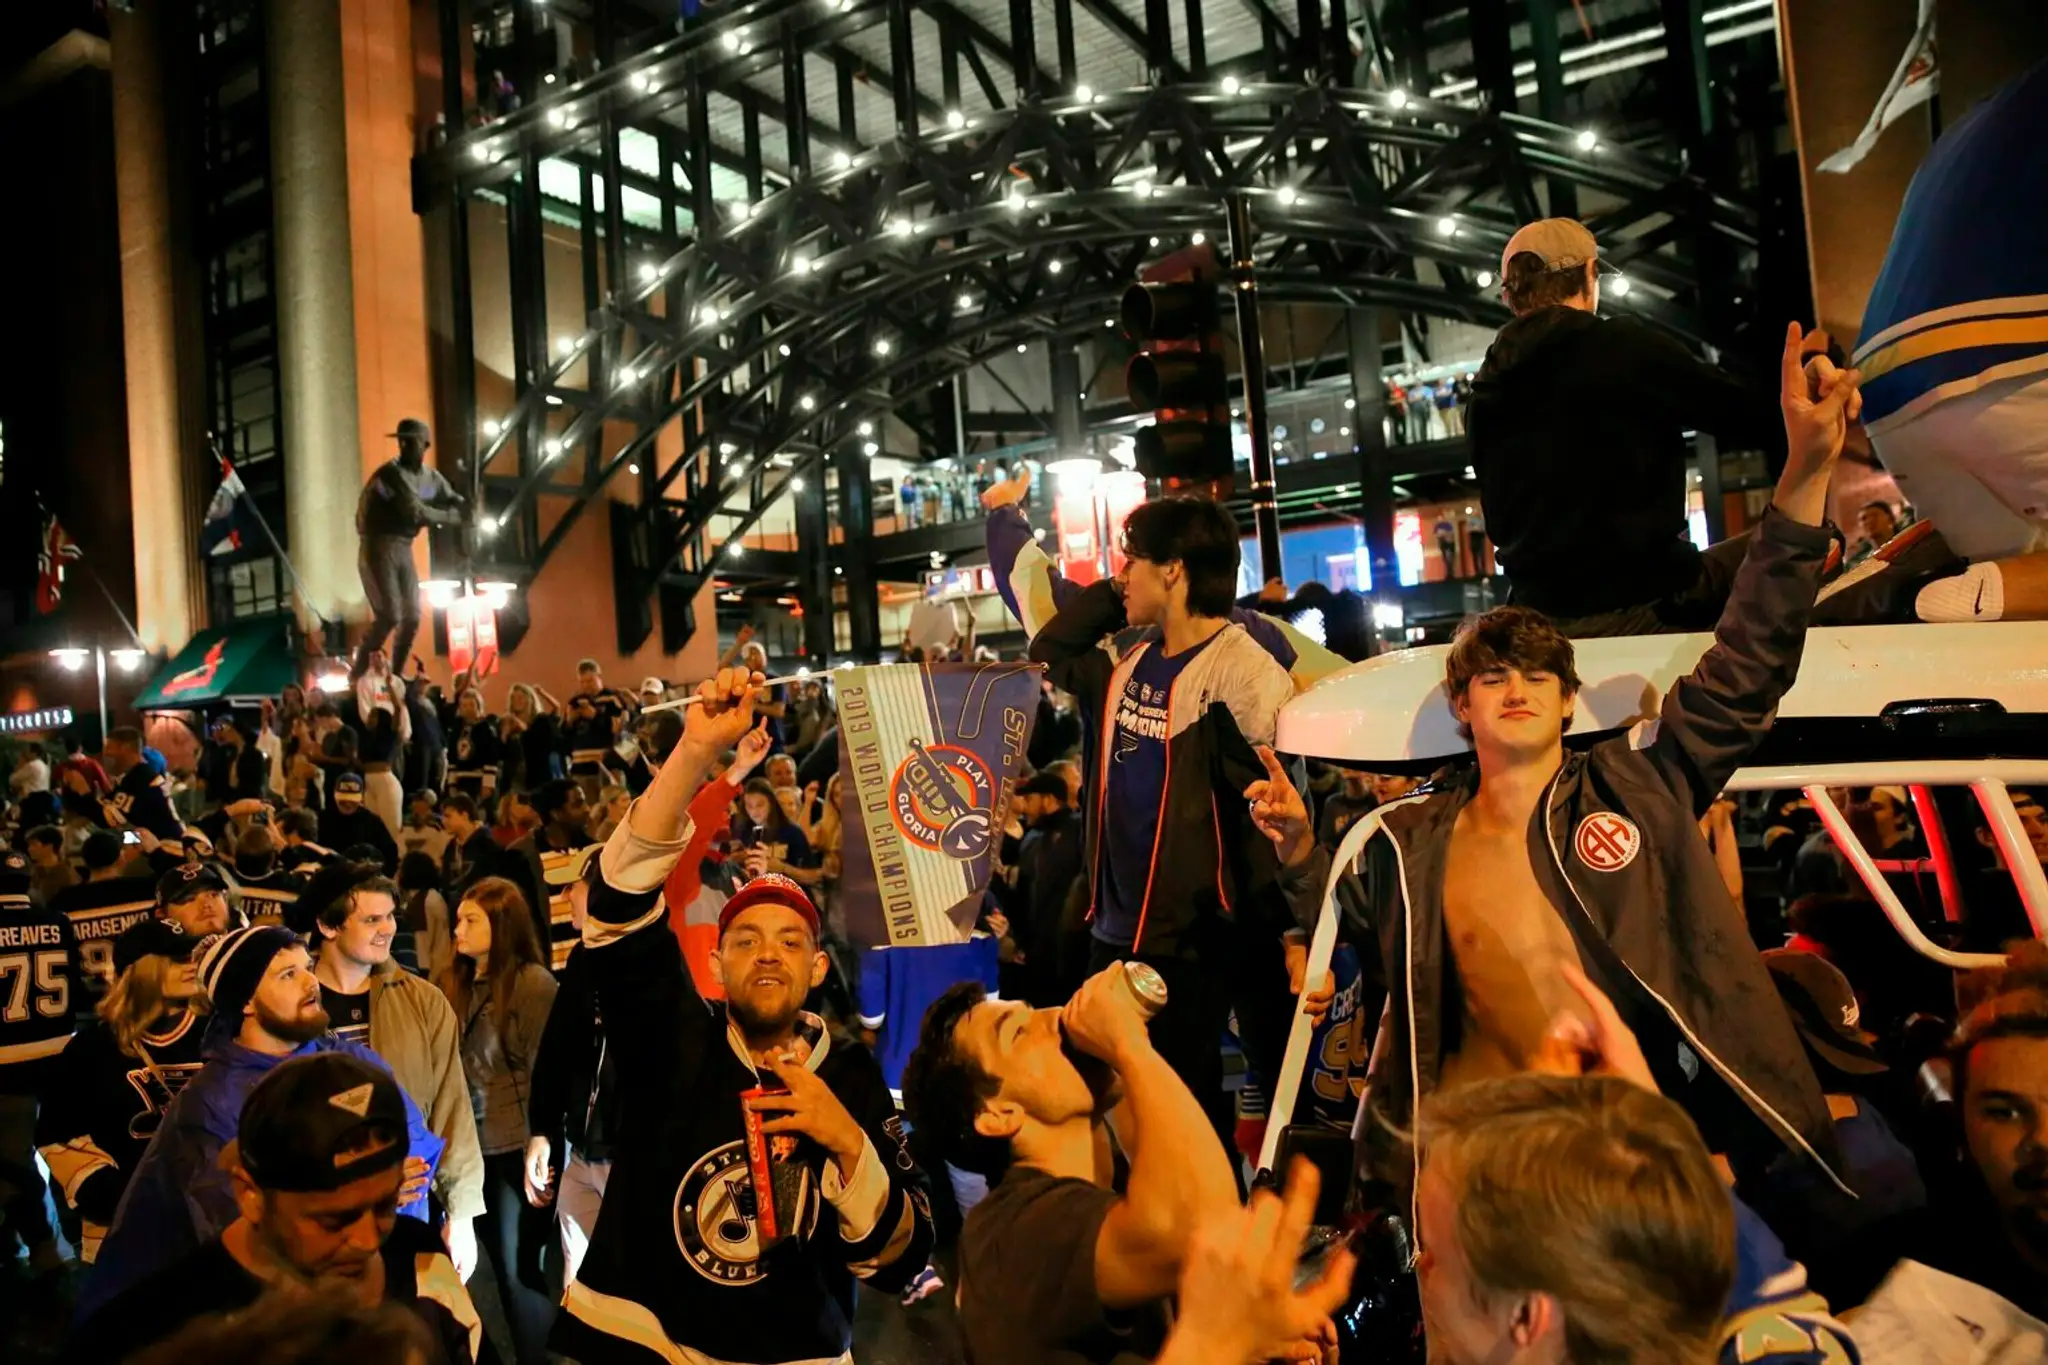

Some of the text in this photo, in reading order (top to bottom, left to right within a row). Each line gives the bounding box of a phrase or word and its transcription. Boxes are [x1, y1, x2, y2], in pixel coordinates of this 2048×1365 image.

[1004, 707, 1027, 767] ST.
[956, 755, 989, 790] PLAY
[841, 686, 918, 940] 2019 WORLD CHAMPIONS
[898, 792, 937, 843] GLORIA
[0, 924, 61, 948] REAVES
[0, 949, 69, 1023] 75
[703, 1151, 742, 1177] ST.
[694, 1248, 770, 1280] BLUE
